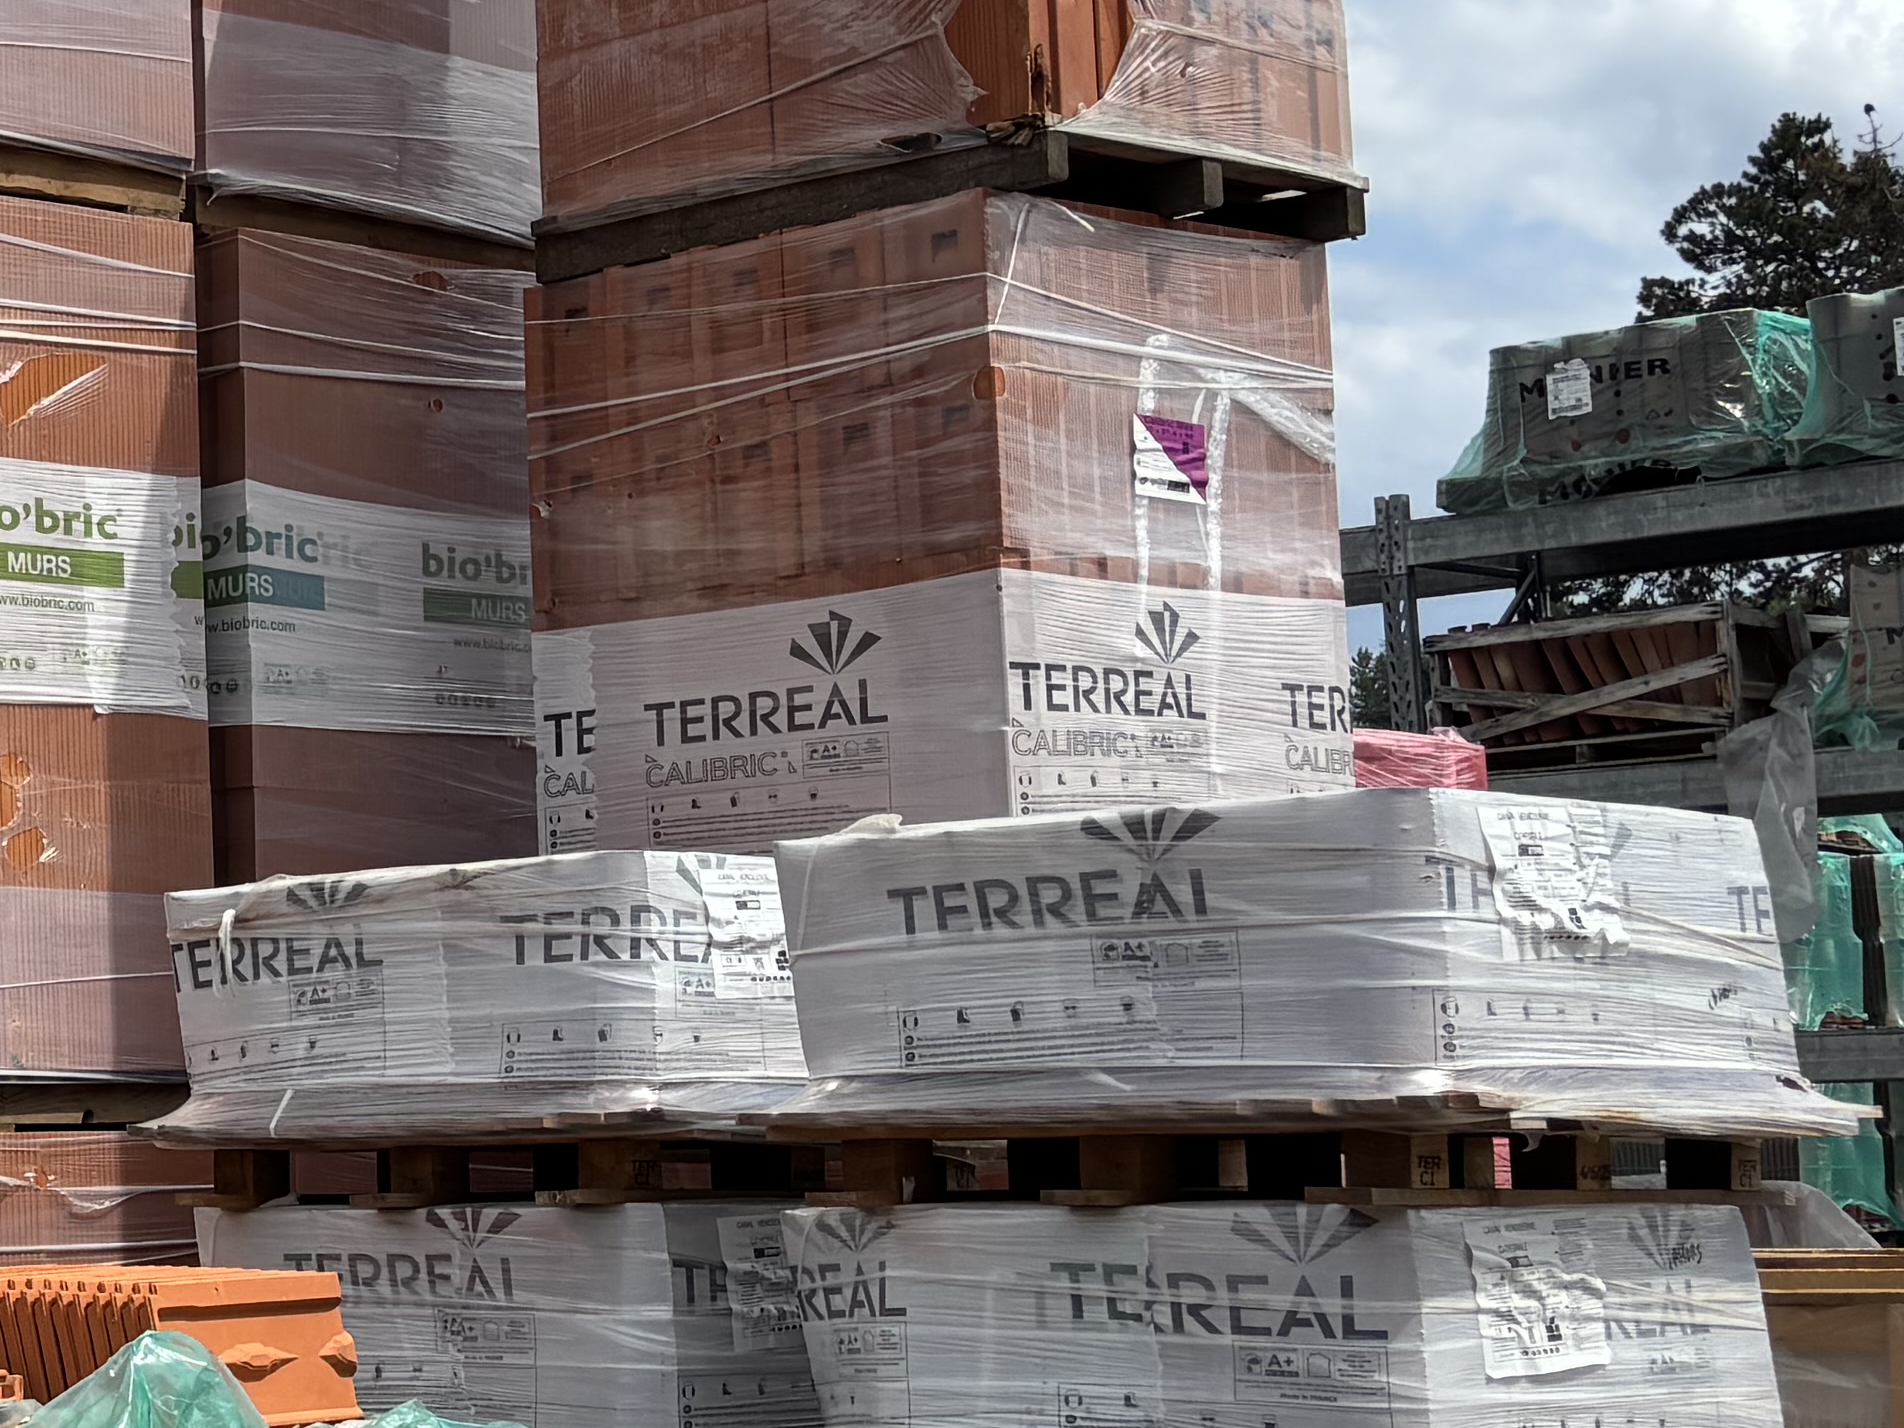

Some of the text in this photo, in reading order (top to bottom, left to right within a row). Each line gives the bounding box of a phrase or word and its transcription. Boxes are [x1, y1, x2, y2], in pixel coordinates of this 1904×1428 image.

[1519, 358, 1671, 403] MNIER
[7, 550, 72, 578] MURS
[206, 573, 275, 602] MURS
[471, 598, 528, 623] MURS
[1008, 661, 1208, 721] TERREAL
[644, 678, 889, 747] TERREAL
[645, 751, 778, 789] CALIBRIC
